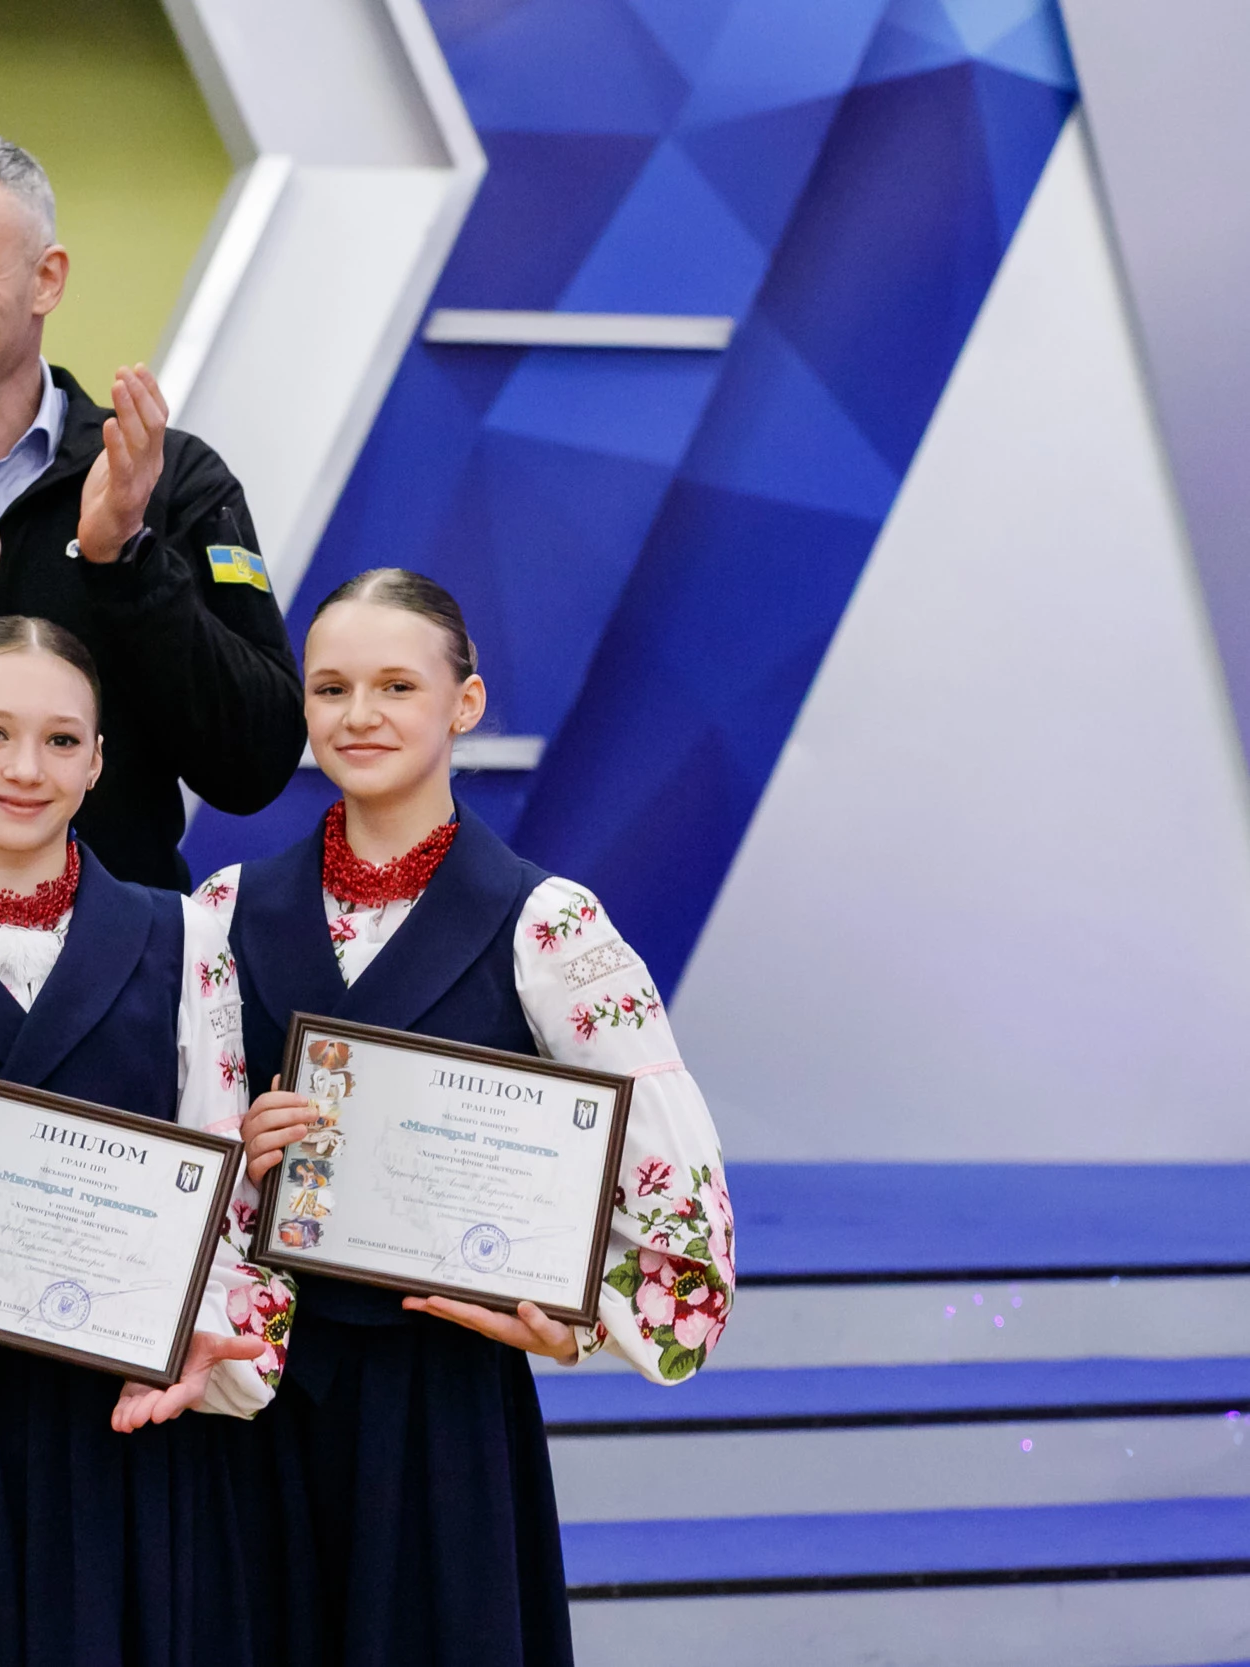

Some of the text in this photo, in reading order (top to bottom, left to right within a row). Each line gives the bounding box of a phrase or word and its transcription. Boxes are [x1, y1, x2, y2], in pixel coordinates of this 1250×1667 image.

[429, 1069, 544, 1105] ДИПЛОМ
[461, 1102, 506, 1117] ГРАН ПРІ
[480, 1120, 519, 1133] конкурсу
[30, 1122, 149, 1165] ДИПЛОМ
[61, 1156, 107, 1174] ГРАН ПРІ
[79, 1175, 119, 1192] конкурсу
